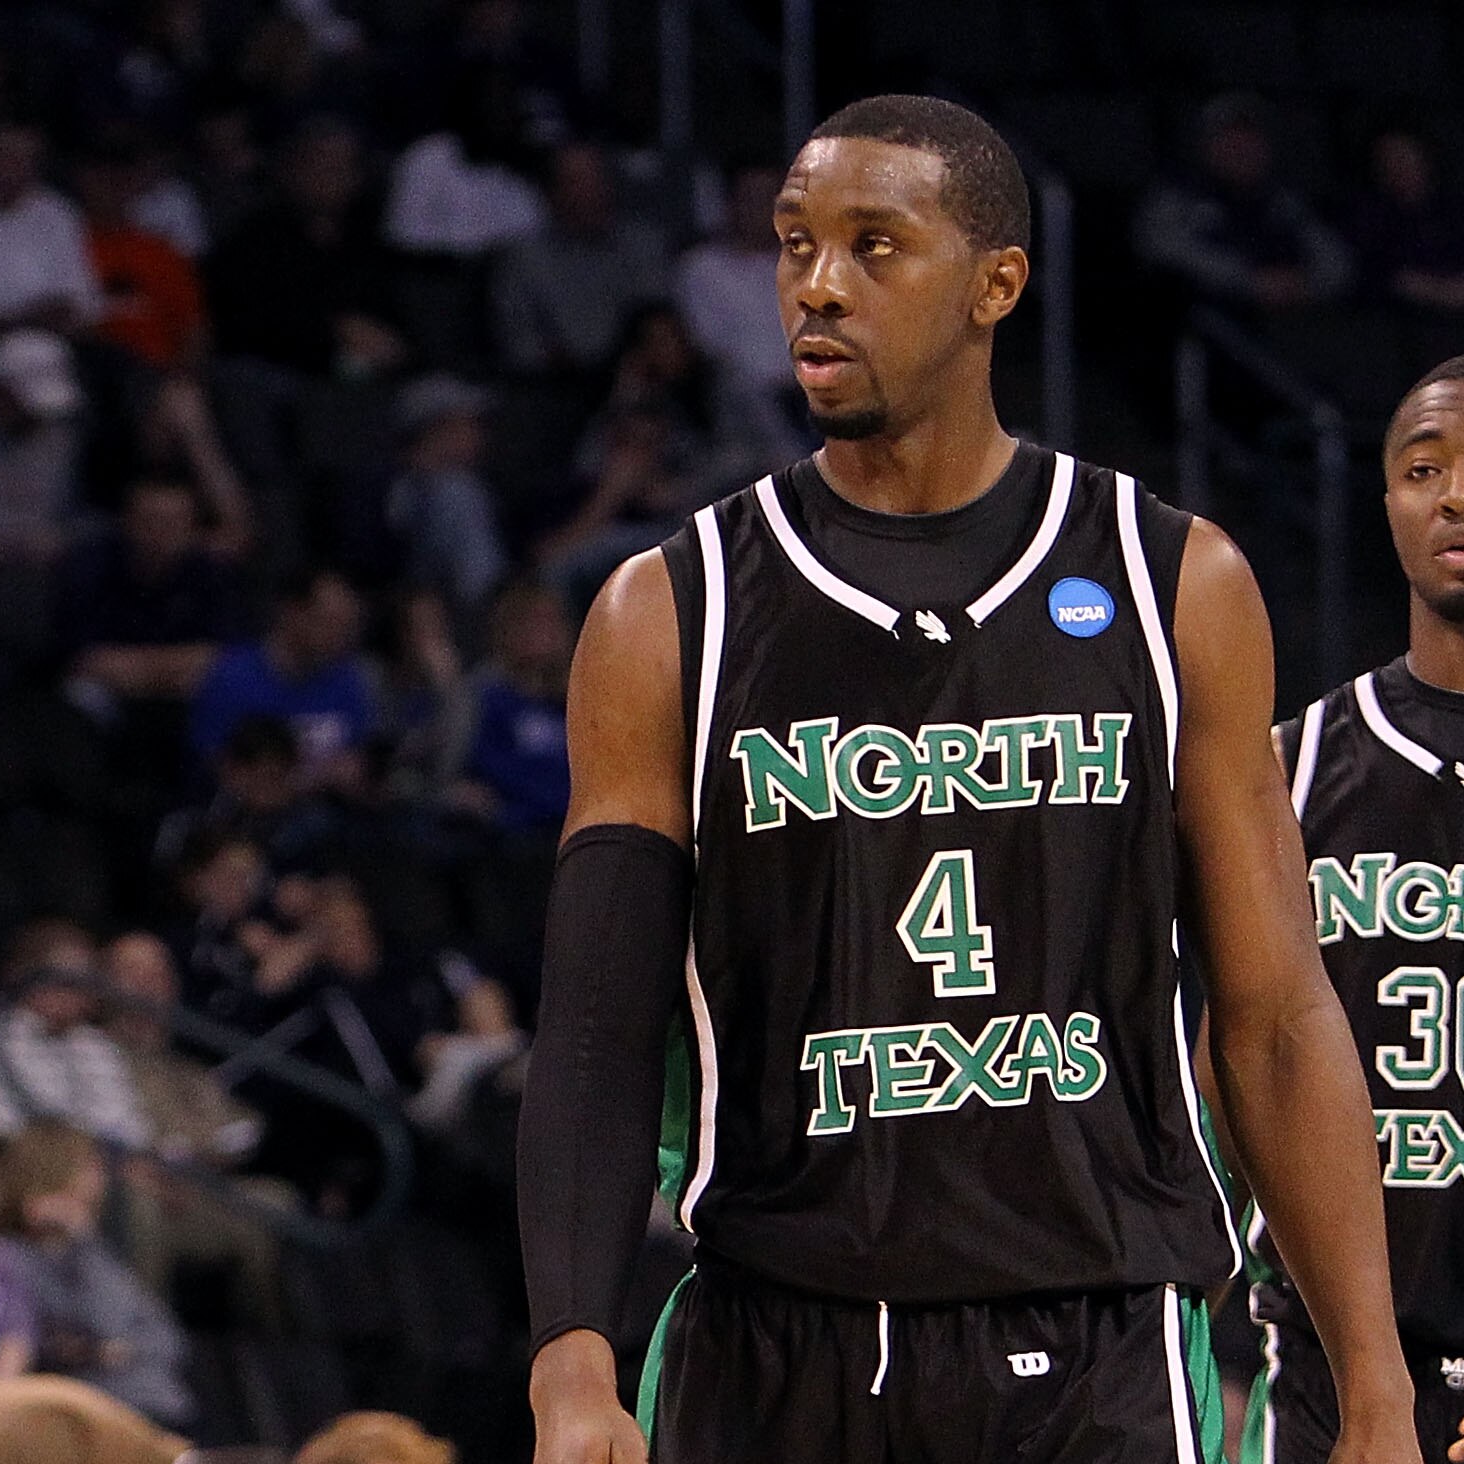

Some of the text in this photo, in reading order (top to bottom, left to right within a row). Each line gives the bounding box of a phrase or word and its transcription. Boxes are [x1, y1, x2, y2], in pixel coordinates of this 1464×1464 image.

[1057, 605, 1106, 623] NCAA
[729, 712, 1133, 833] NORTH
[896, 849, 996, 998] 4
[800, 1012, 1107, 1136] TEXAS
